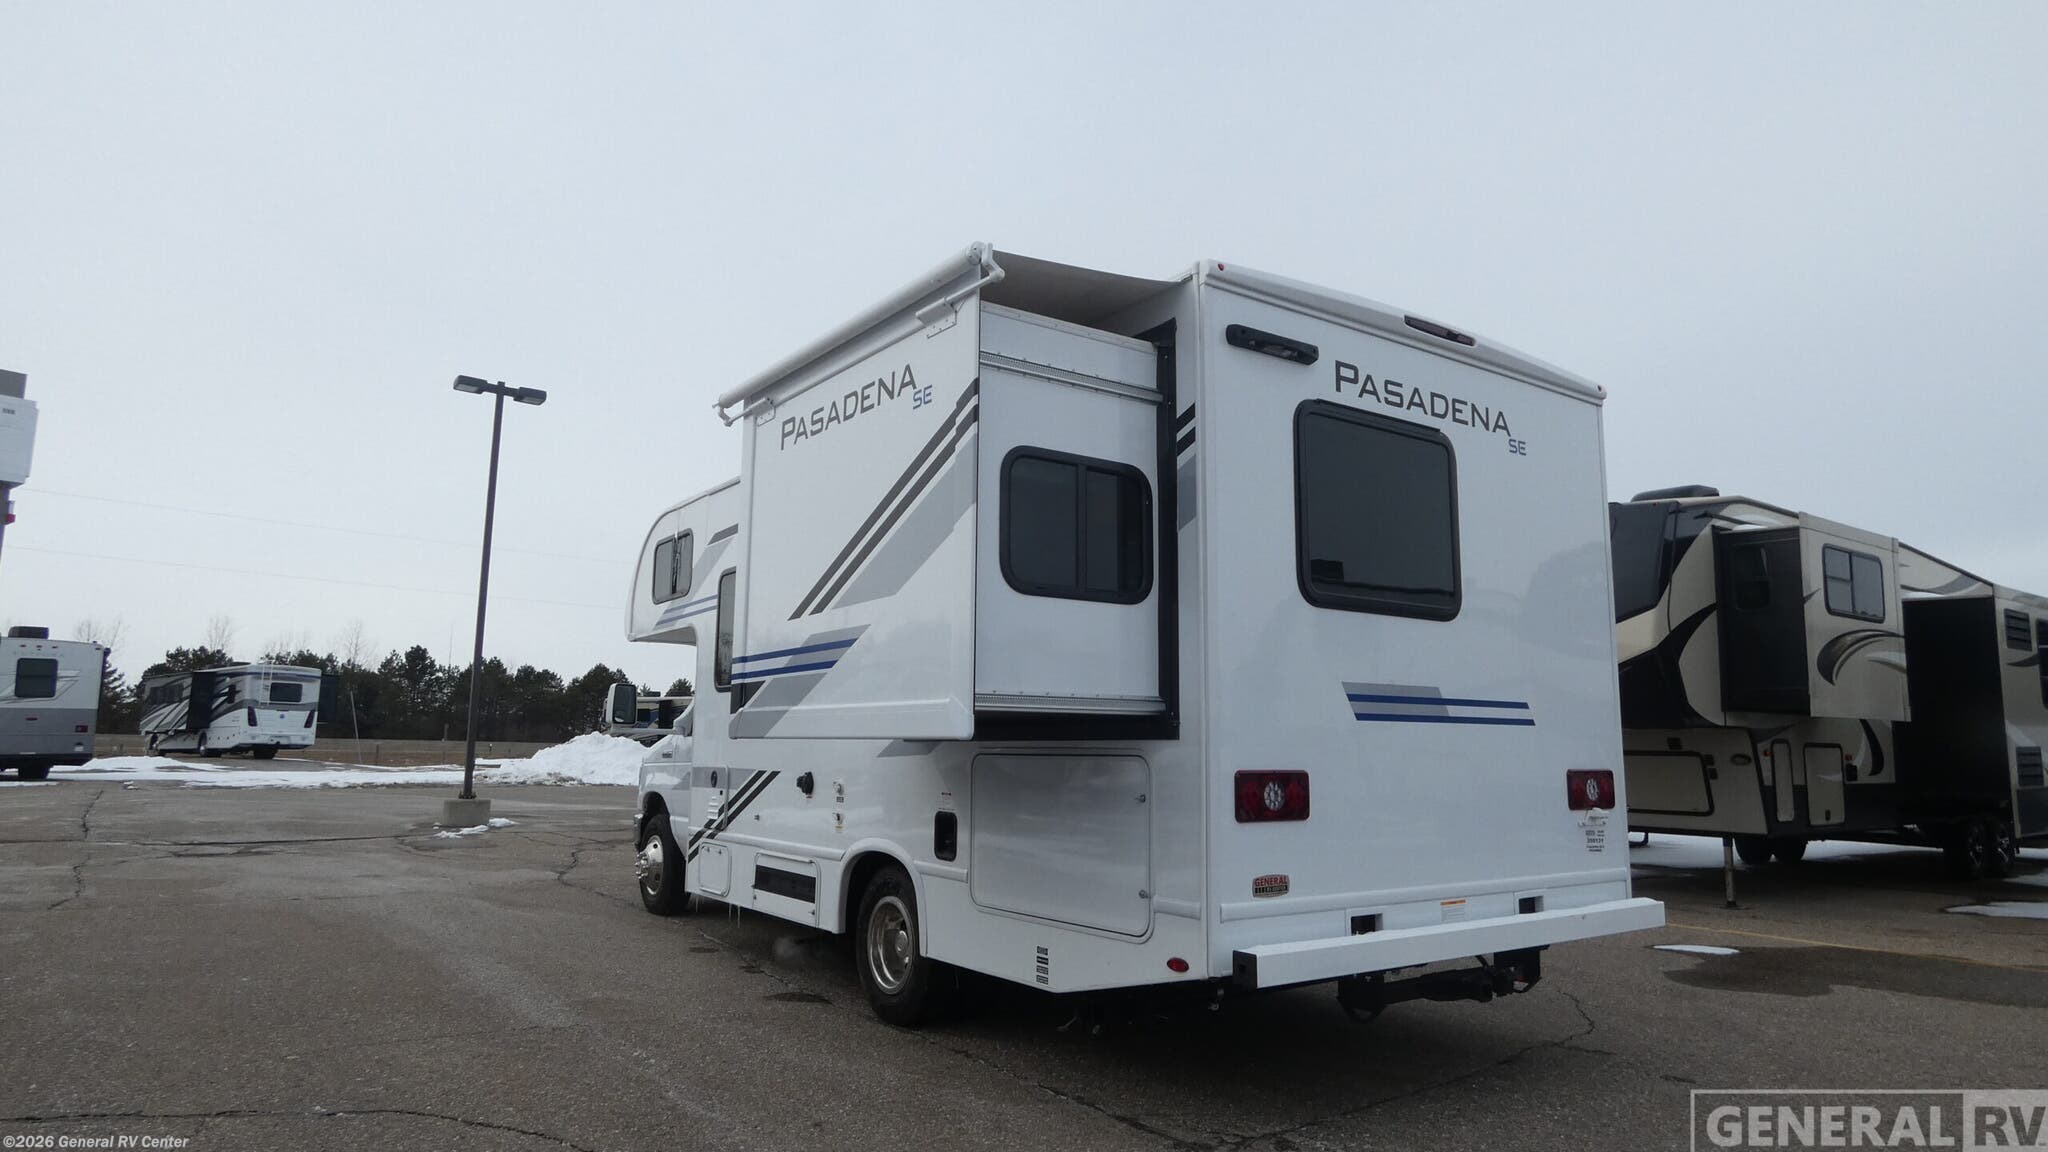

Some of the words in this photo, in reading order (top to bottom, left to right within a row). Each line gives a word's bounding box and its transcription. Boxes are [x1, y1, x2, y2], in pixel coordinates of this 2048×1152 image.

[781, 363, 917, 451] PASADENA
[912, 384, 933, 410] SE
[1335, 360, 1511, 437] PASADENA
[1508, 438, 1527, 456] SE
[1254, 875, 1288, 887] GENERAL
